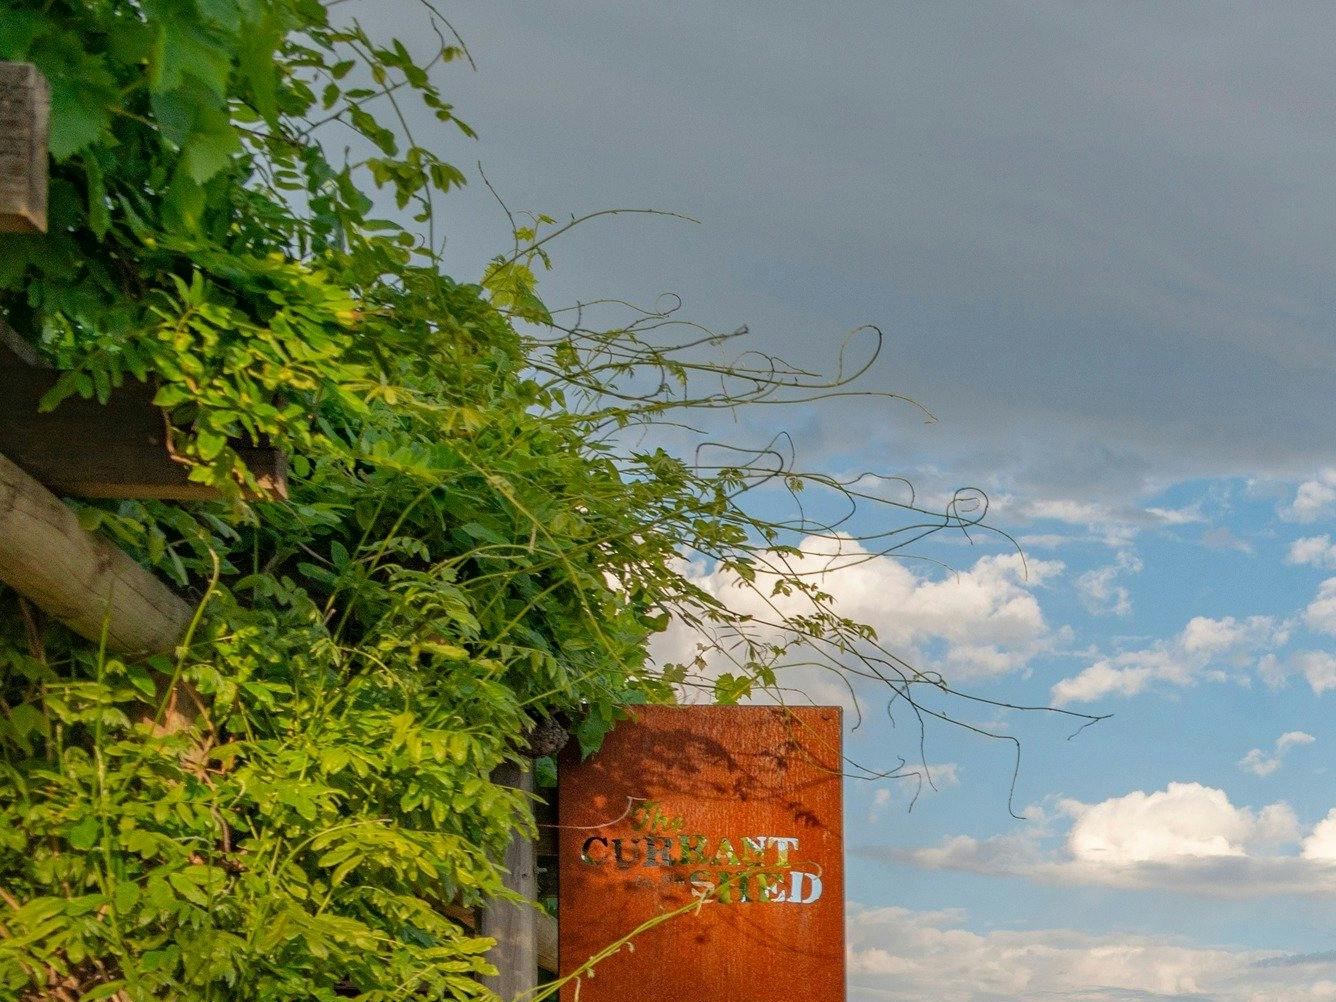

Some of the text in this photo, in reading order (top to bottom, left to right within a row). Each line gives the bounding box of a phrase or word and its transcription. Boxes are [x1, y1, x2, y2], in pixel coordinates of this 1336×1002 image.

[631, 801, 684, 832] The
[581, 836, 799, 868] CURRANT
[690, 870, 823, 904] SHED
